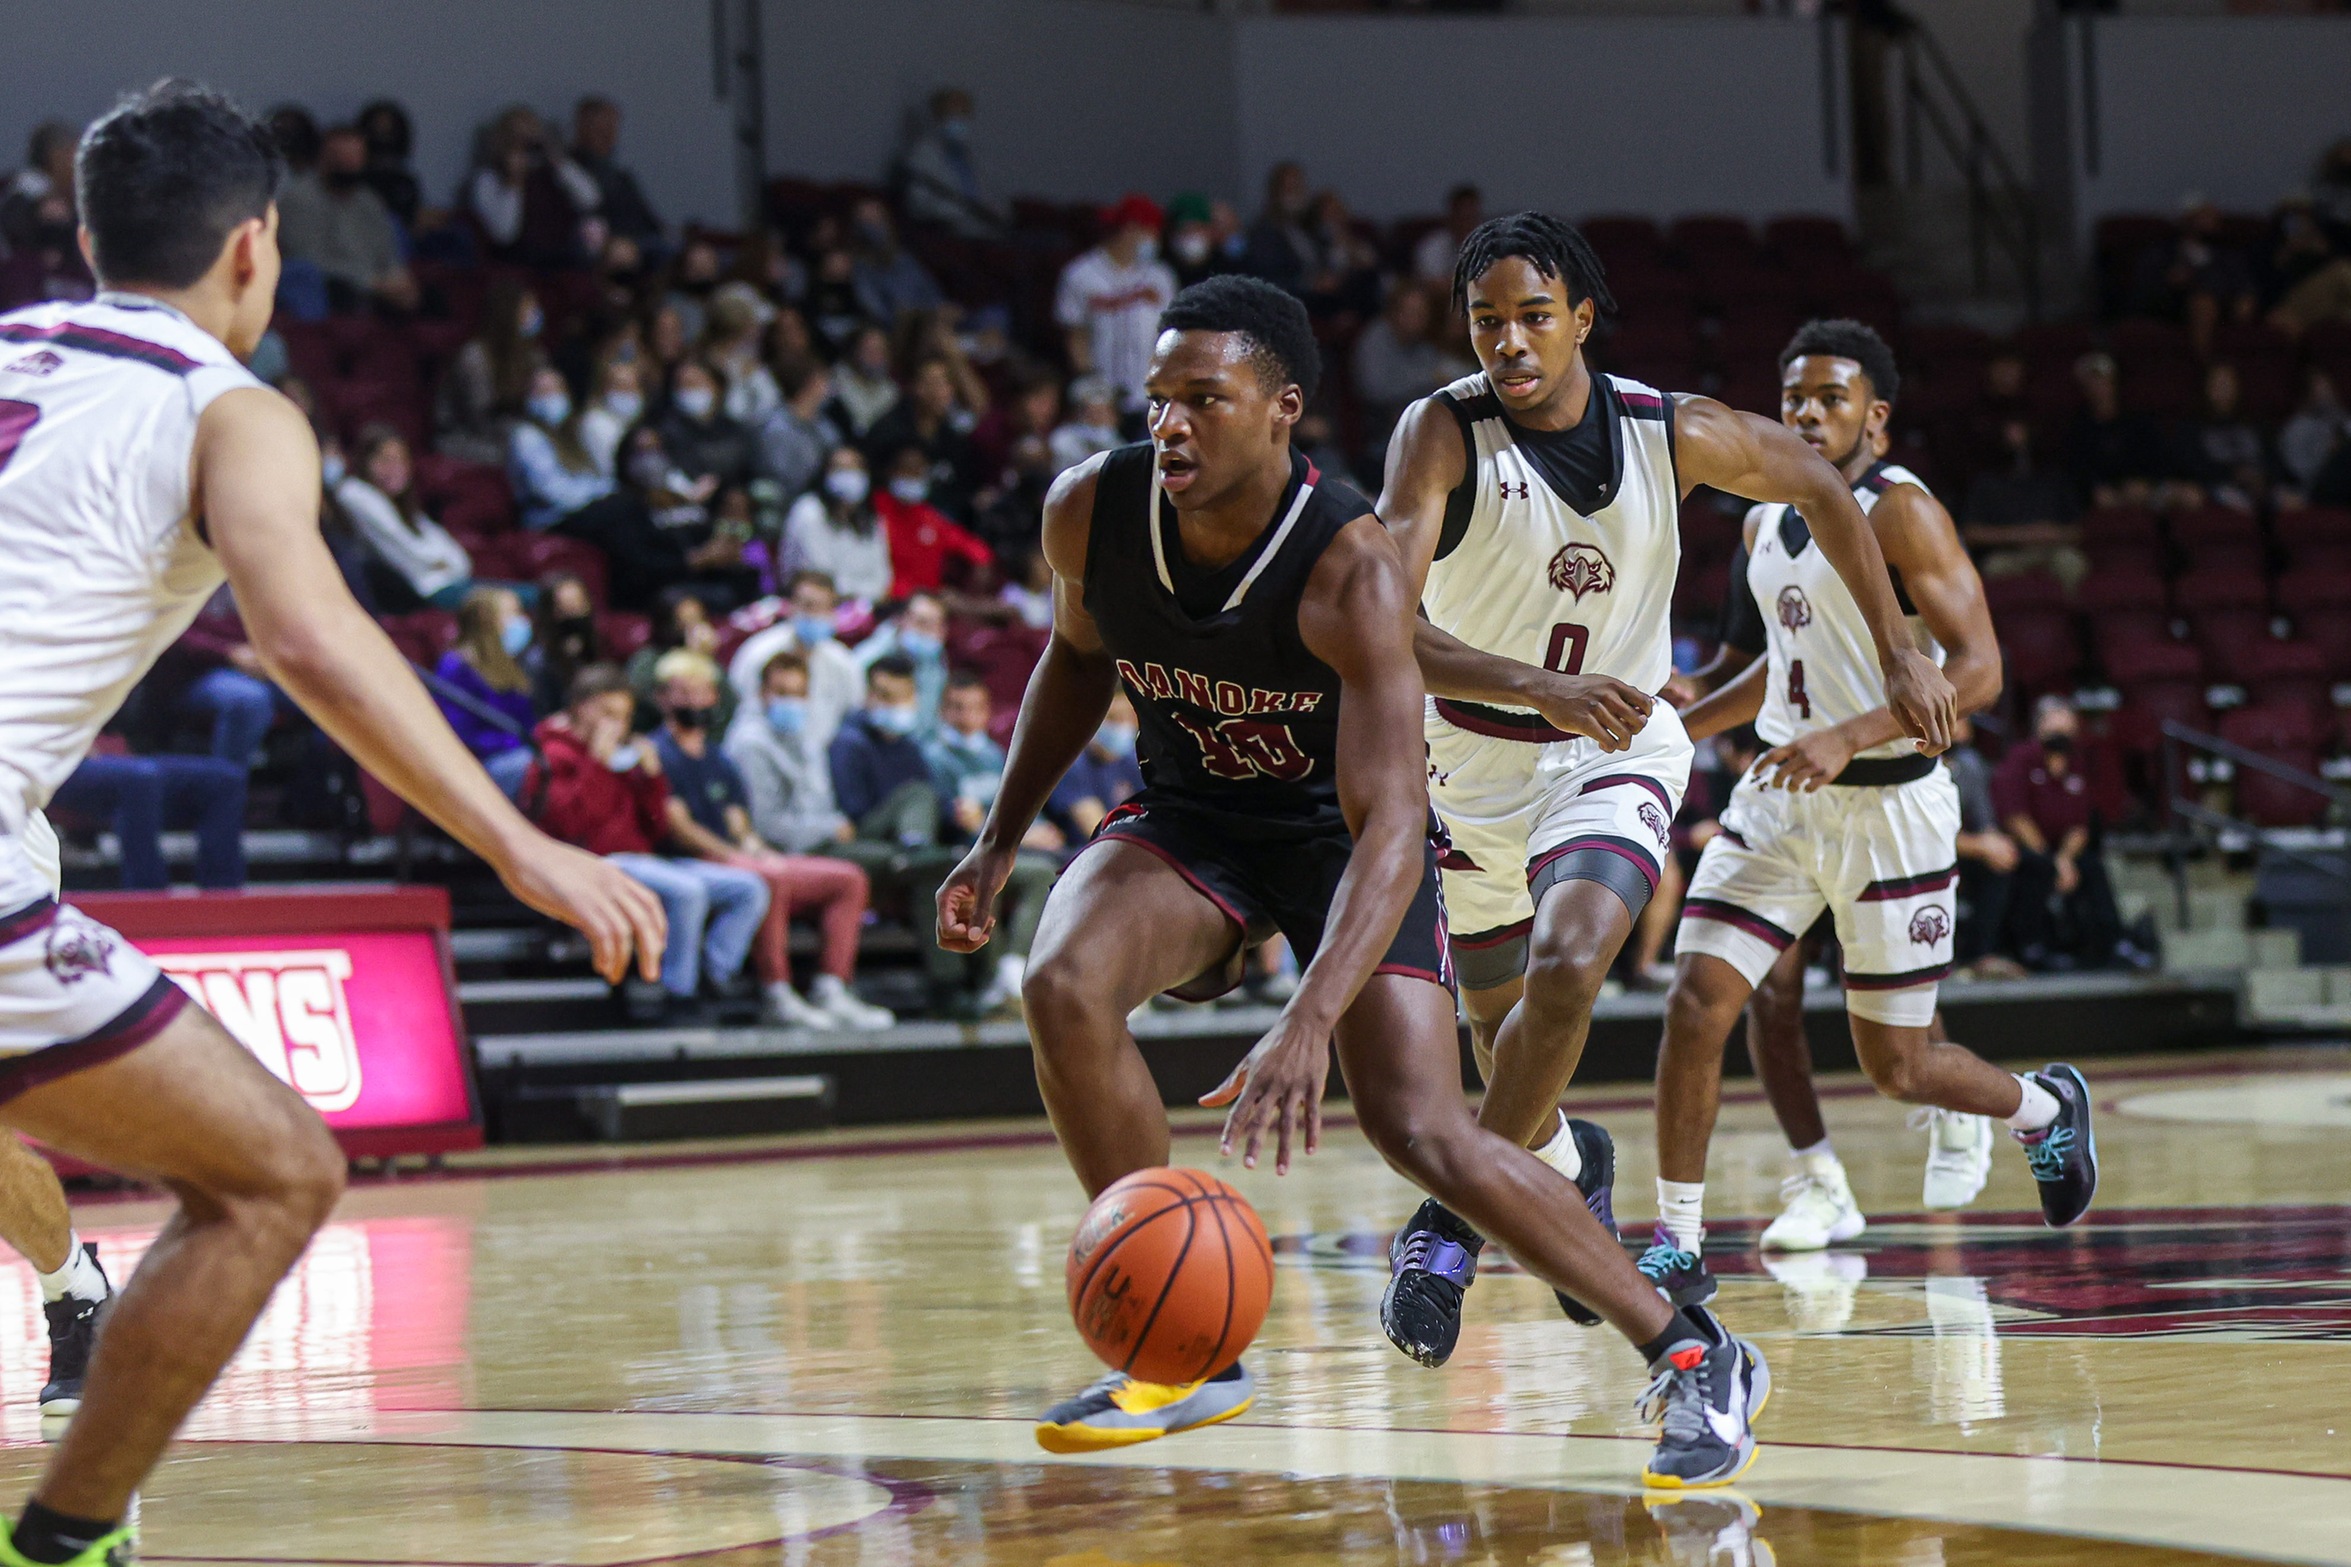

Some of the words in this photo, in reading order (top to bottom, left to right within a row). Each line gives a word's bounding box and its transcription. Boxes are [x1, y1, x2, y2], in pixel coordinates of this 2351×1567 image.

[1542, 622, 1590, 676] 0
[1116, 658, 1324, 717] OANOKE
[1788, 659, 1811, 719] 4
[1170, 711, 1315, 782] 10
[162, 952, 360, 1110] NS
